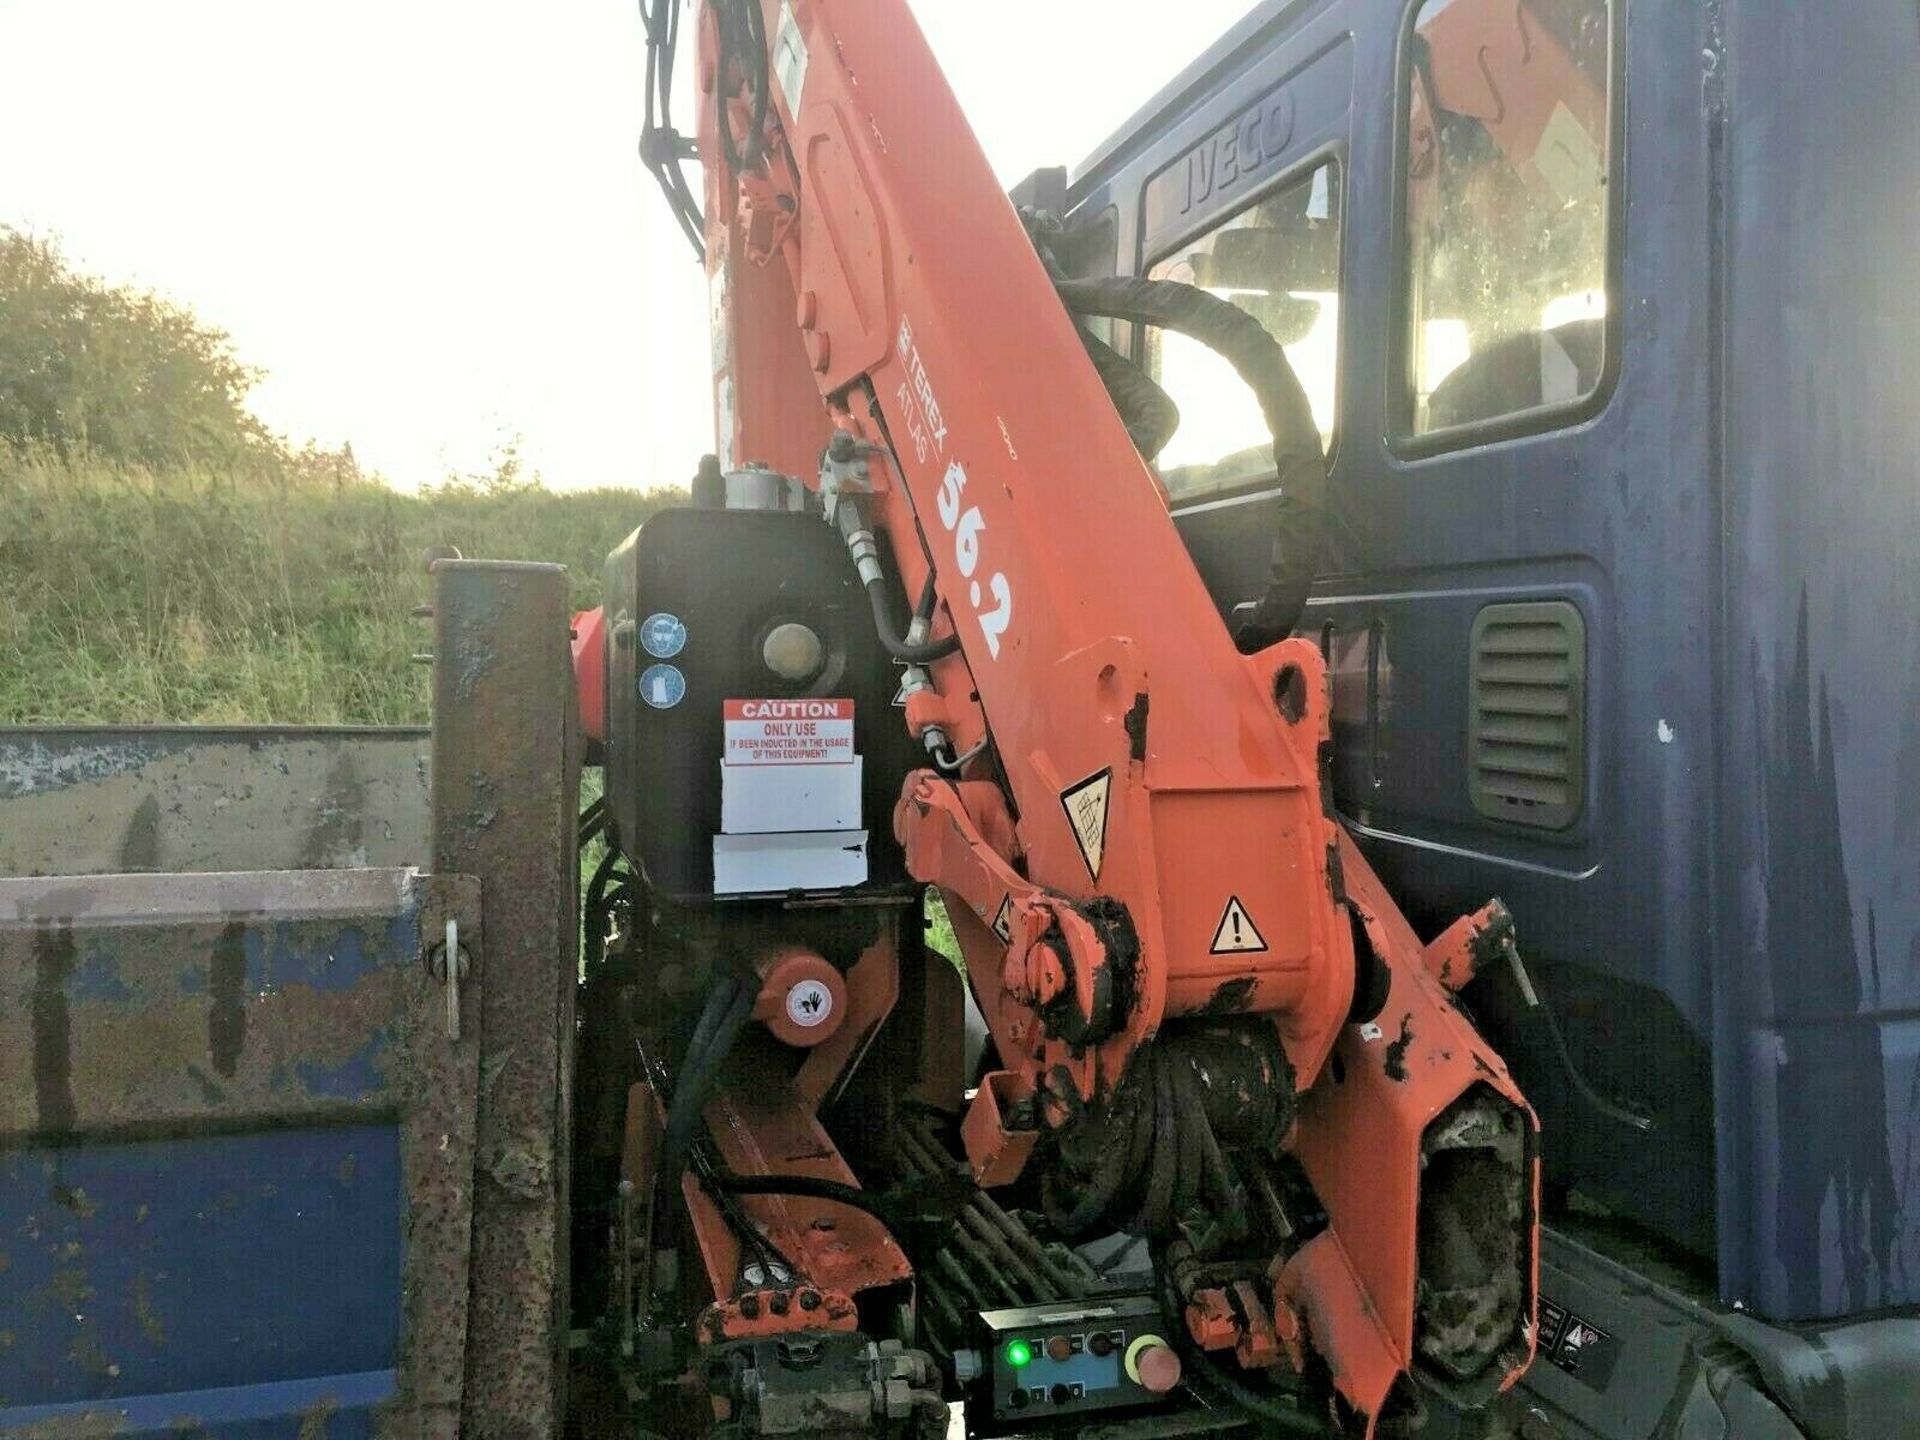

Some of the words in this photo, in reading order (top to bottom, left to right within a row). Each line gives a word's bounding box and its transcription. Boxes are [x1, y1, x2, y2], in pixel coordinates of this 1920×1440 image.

[1180, 93, 1296, 214] IVECO
[896, 382, 929, 465] ATLAS
[909, 345, 947, 453] TEREX
[936, 457, 1013, 663] 56.2
[741, 702, 839, 718] CAUTION
[763, 723, 792, 737] ONLY
[796, 723, 817, 737] USE
[730, 739, 737, 749] IF
[738, 739, 759, 749] BEEN
[760, 738, 798, 749] INDUCTED
[798, 738, 808, 748] IN
[809, 738, 823, 748] THE
[825, 737, 849, 748] USAGE
[752, 749, 763, 760] OF
[765, 749, 782, 759] THIS
